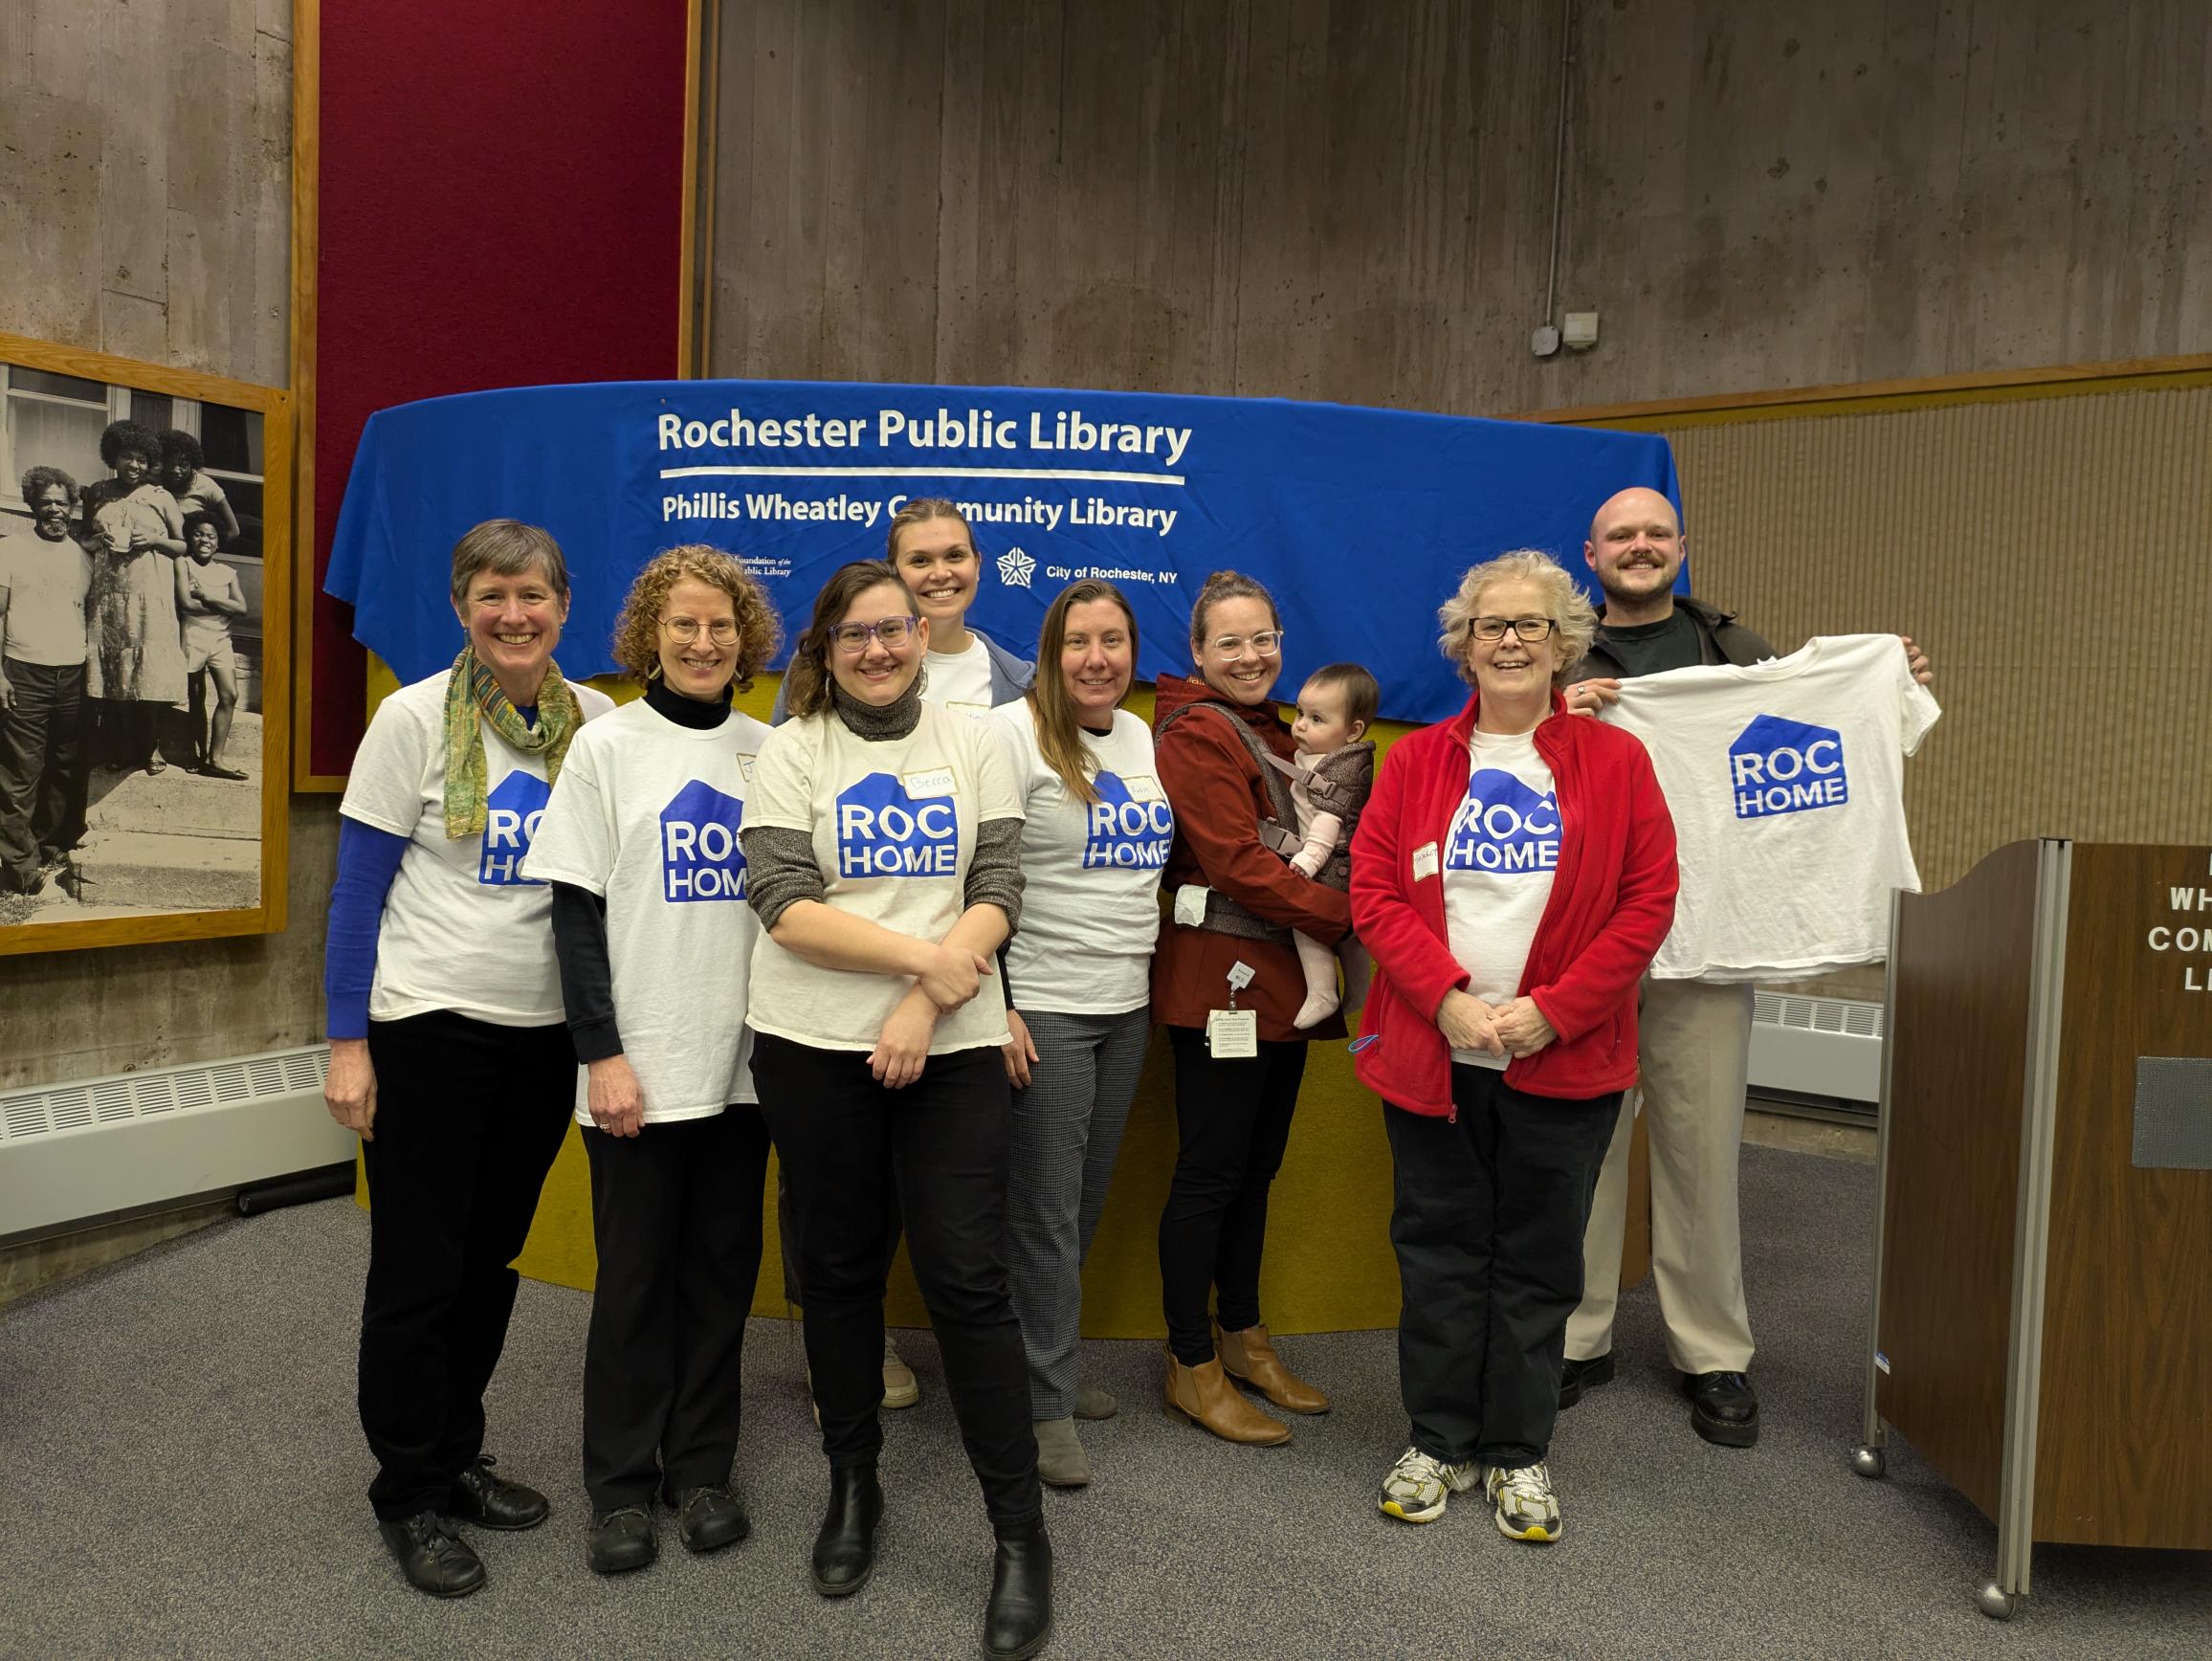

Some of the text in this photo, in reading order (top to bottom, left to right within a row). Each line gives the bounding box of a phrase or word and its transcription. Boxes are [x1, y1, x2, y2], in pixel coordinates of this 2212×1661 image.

[658, 408, 1192, 466] Rochester Public Library
[662, 492, 1178, 537] Phillis Wheatley Cmunity Library
[763, 566, 791, 578] Library
[1046, 565, 1178, 585] City of Rochester, NY
[1734, 740, 1840, 786] ROC
[1738, 777, 1845, 815] HOME
[841, 804, 955, 842] ROC
[1091, 801, 1172, 837] ROC
[1456, 797, 1559, 840] ROC
[843, 844, 956, 875] HOME
[1088, 838, 1171, 867] HOME
[1449, 838, 1559, 870] HOME
